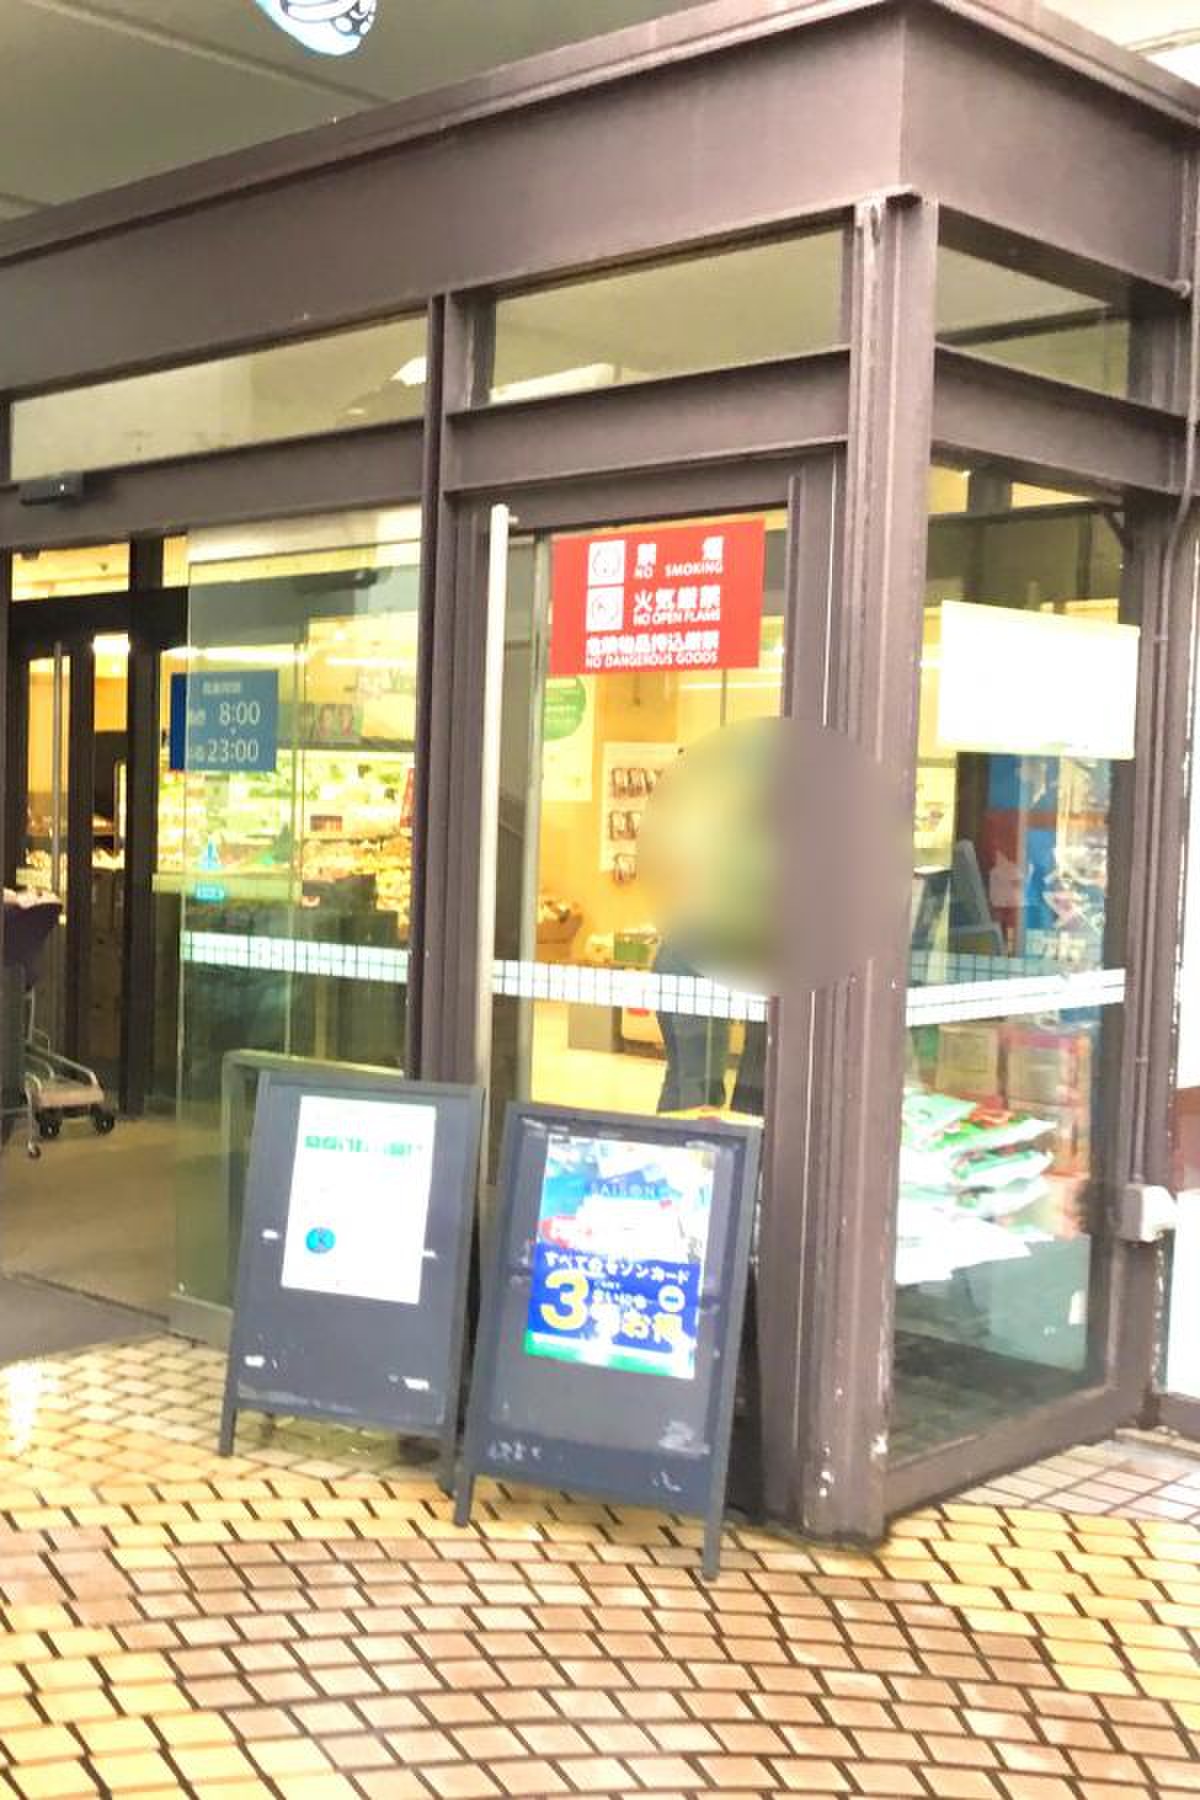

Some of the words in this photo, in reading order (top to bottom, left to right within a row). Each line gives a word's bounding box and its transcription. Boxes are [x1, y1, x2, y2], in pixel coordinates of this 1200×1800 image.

[636, 565, 653, 579] NO
[665, 560, 724, 578] SMOKING
[633, 610, 651, 626] NO
[652, 609, 682, 625] OPEN
[675, 650, 719, 665] GOODS
[219, 701, 261, 727] 8:00
[207, 738, 259, 763] 23:00
